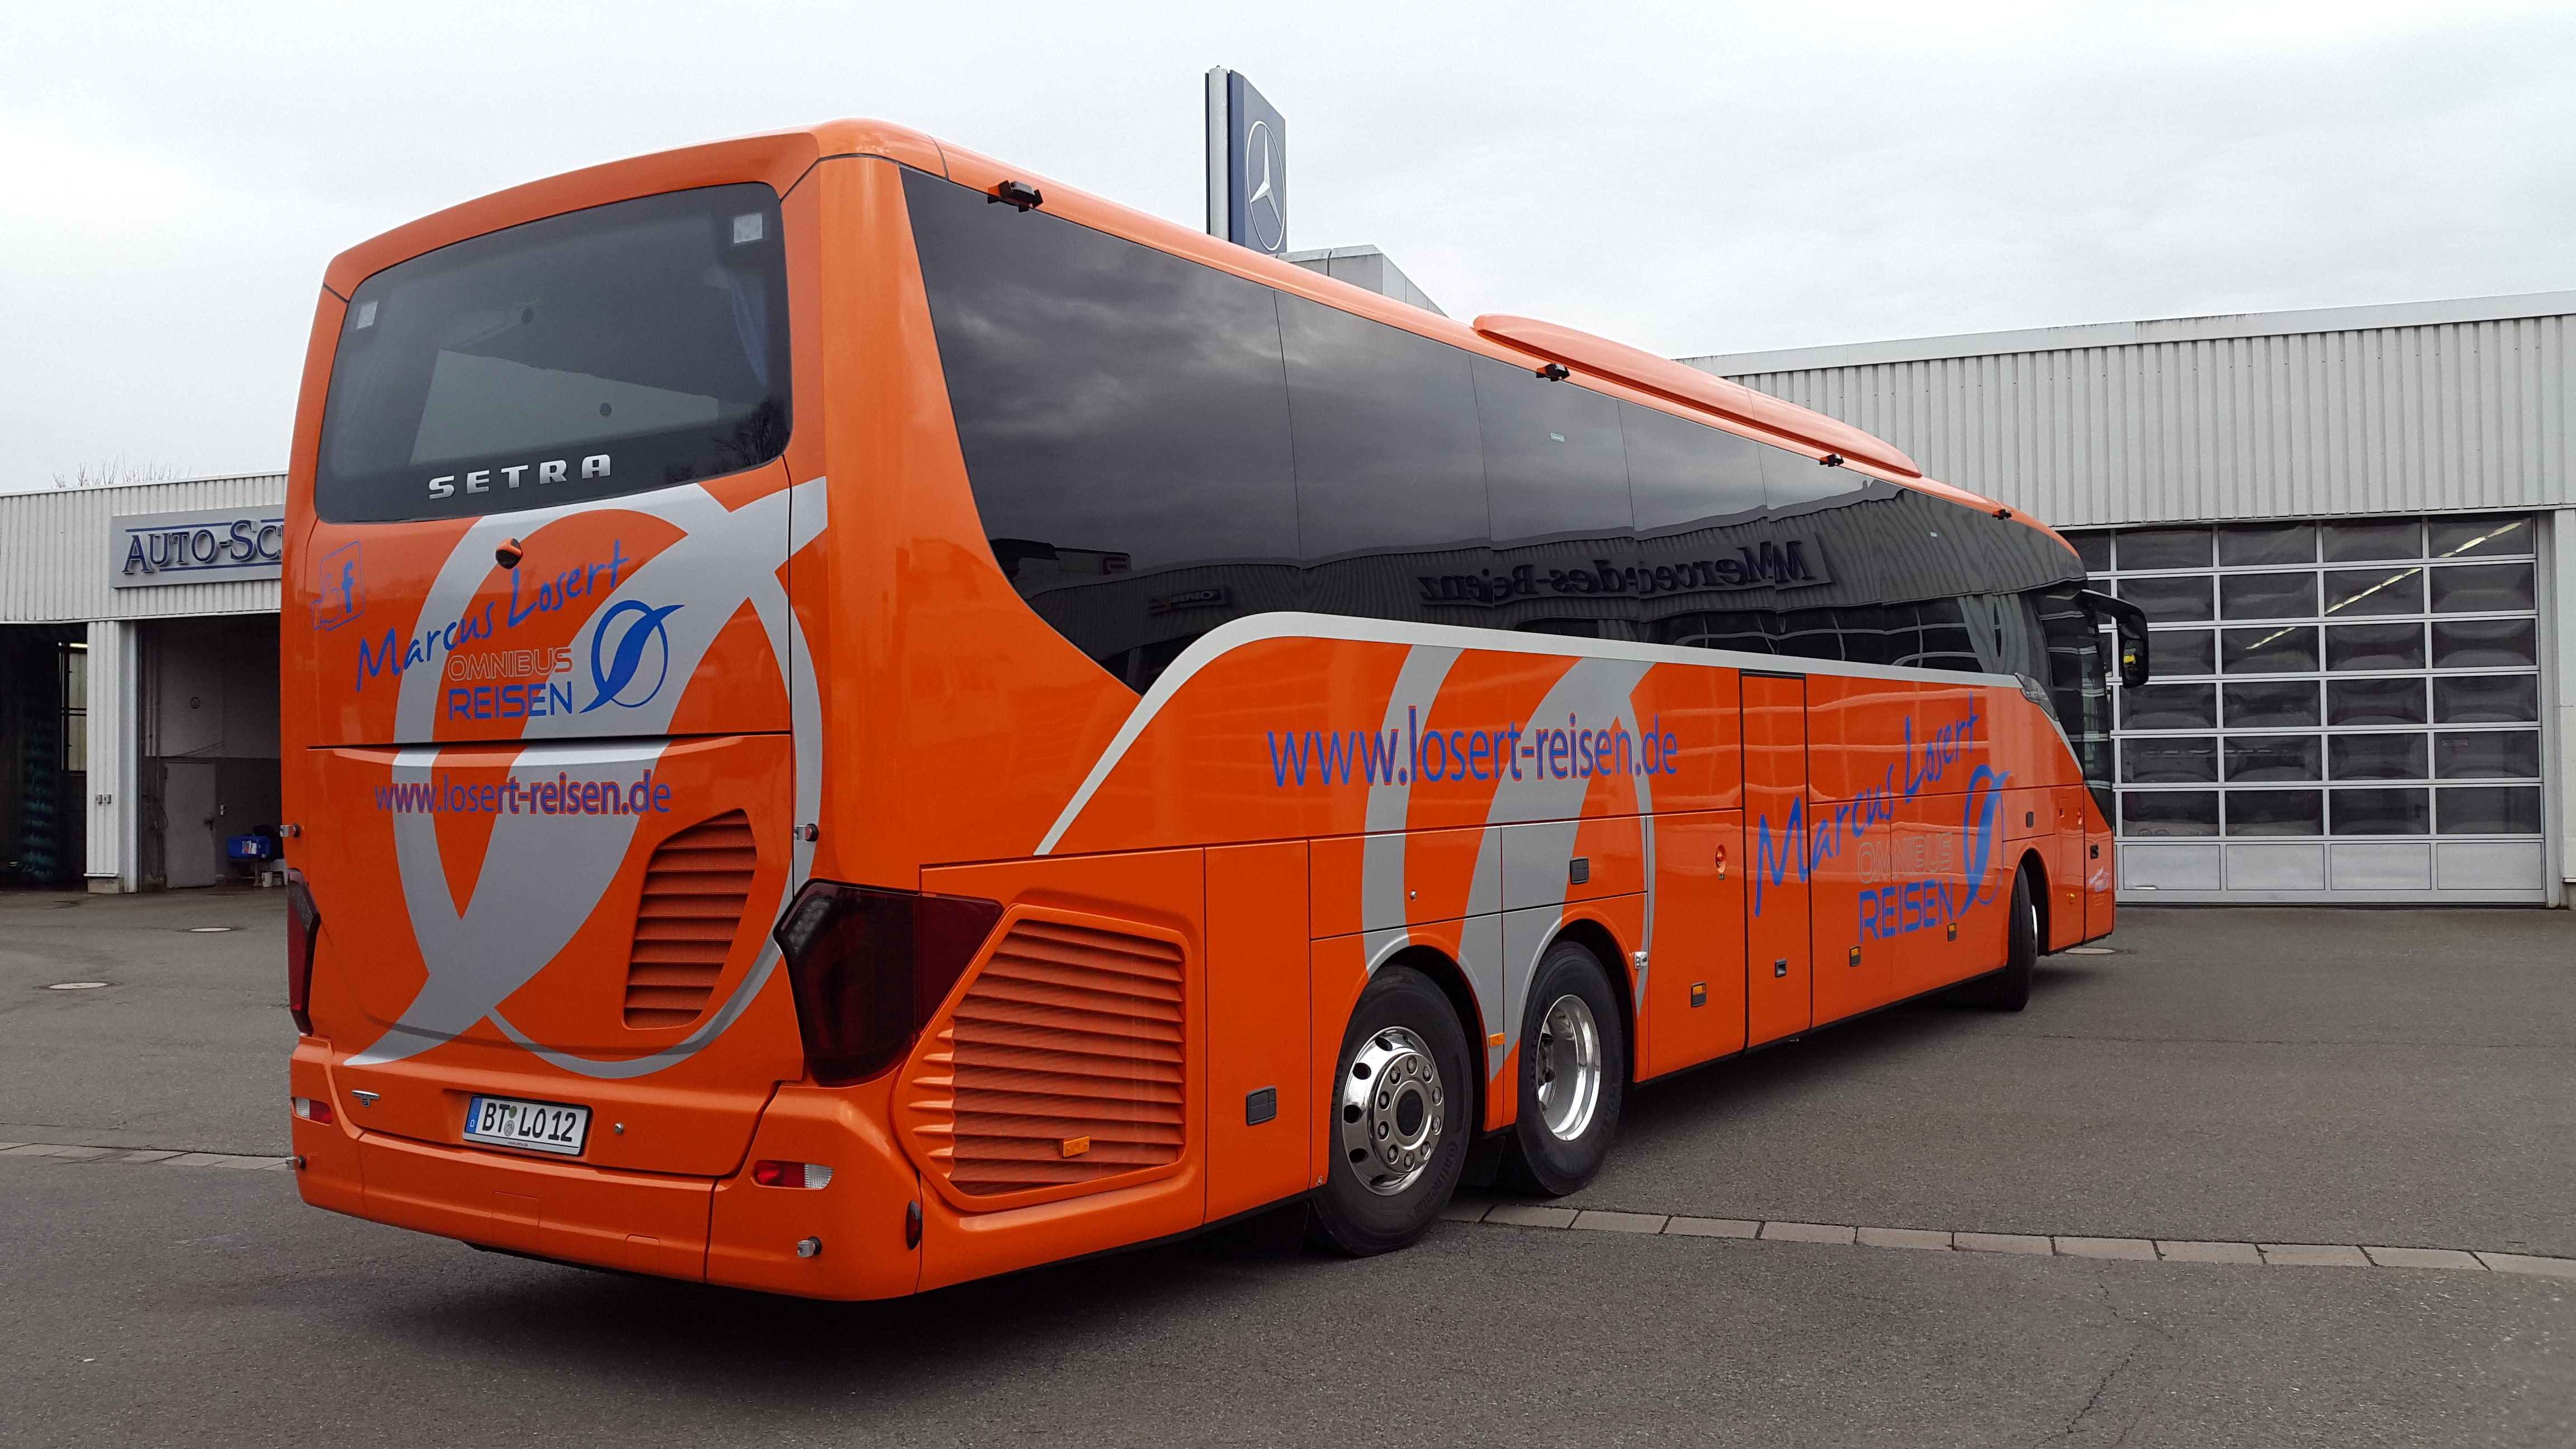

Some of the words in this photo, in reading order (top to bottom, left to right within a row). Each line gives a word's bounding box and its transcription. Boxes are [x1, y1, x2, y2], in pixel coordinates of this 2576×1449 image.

[428, 454, 612, 500] SETRA
[121, 520, 284, 575] AUTO-SC
[356, 600, 495, 693] Marcus
[507, 539, 629, 628] Losert
[448, 647, 573, 681] OMNIBUS
[448, 681, 572, 720] REISEN
[1267, 705, 1677, 787] www.losert-reisen.de
[374, 769, 671, 814] www.losert-reisen.de
[1754, 763, 1895, 917] Marcus
[1904, 690, 1979, 804] Losert
[1858, 832, 1953, 884] OMNIBUS
[1859, 876, 1953, 944] REISEN
[470, 1119, 475, 1128] D
[482, 1102, 510, 1133] BT
